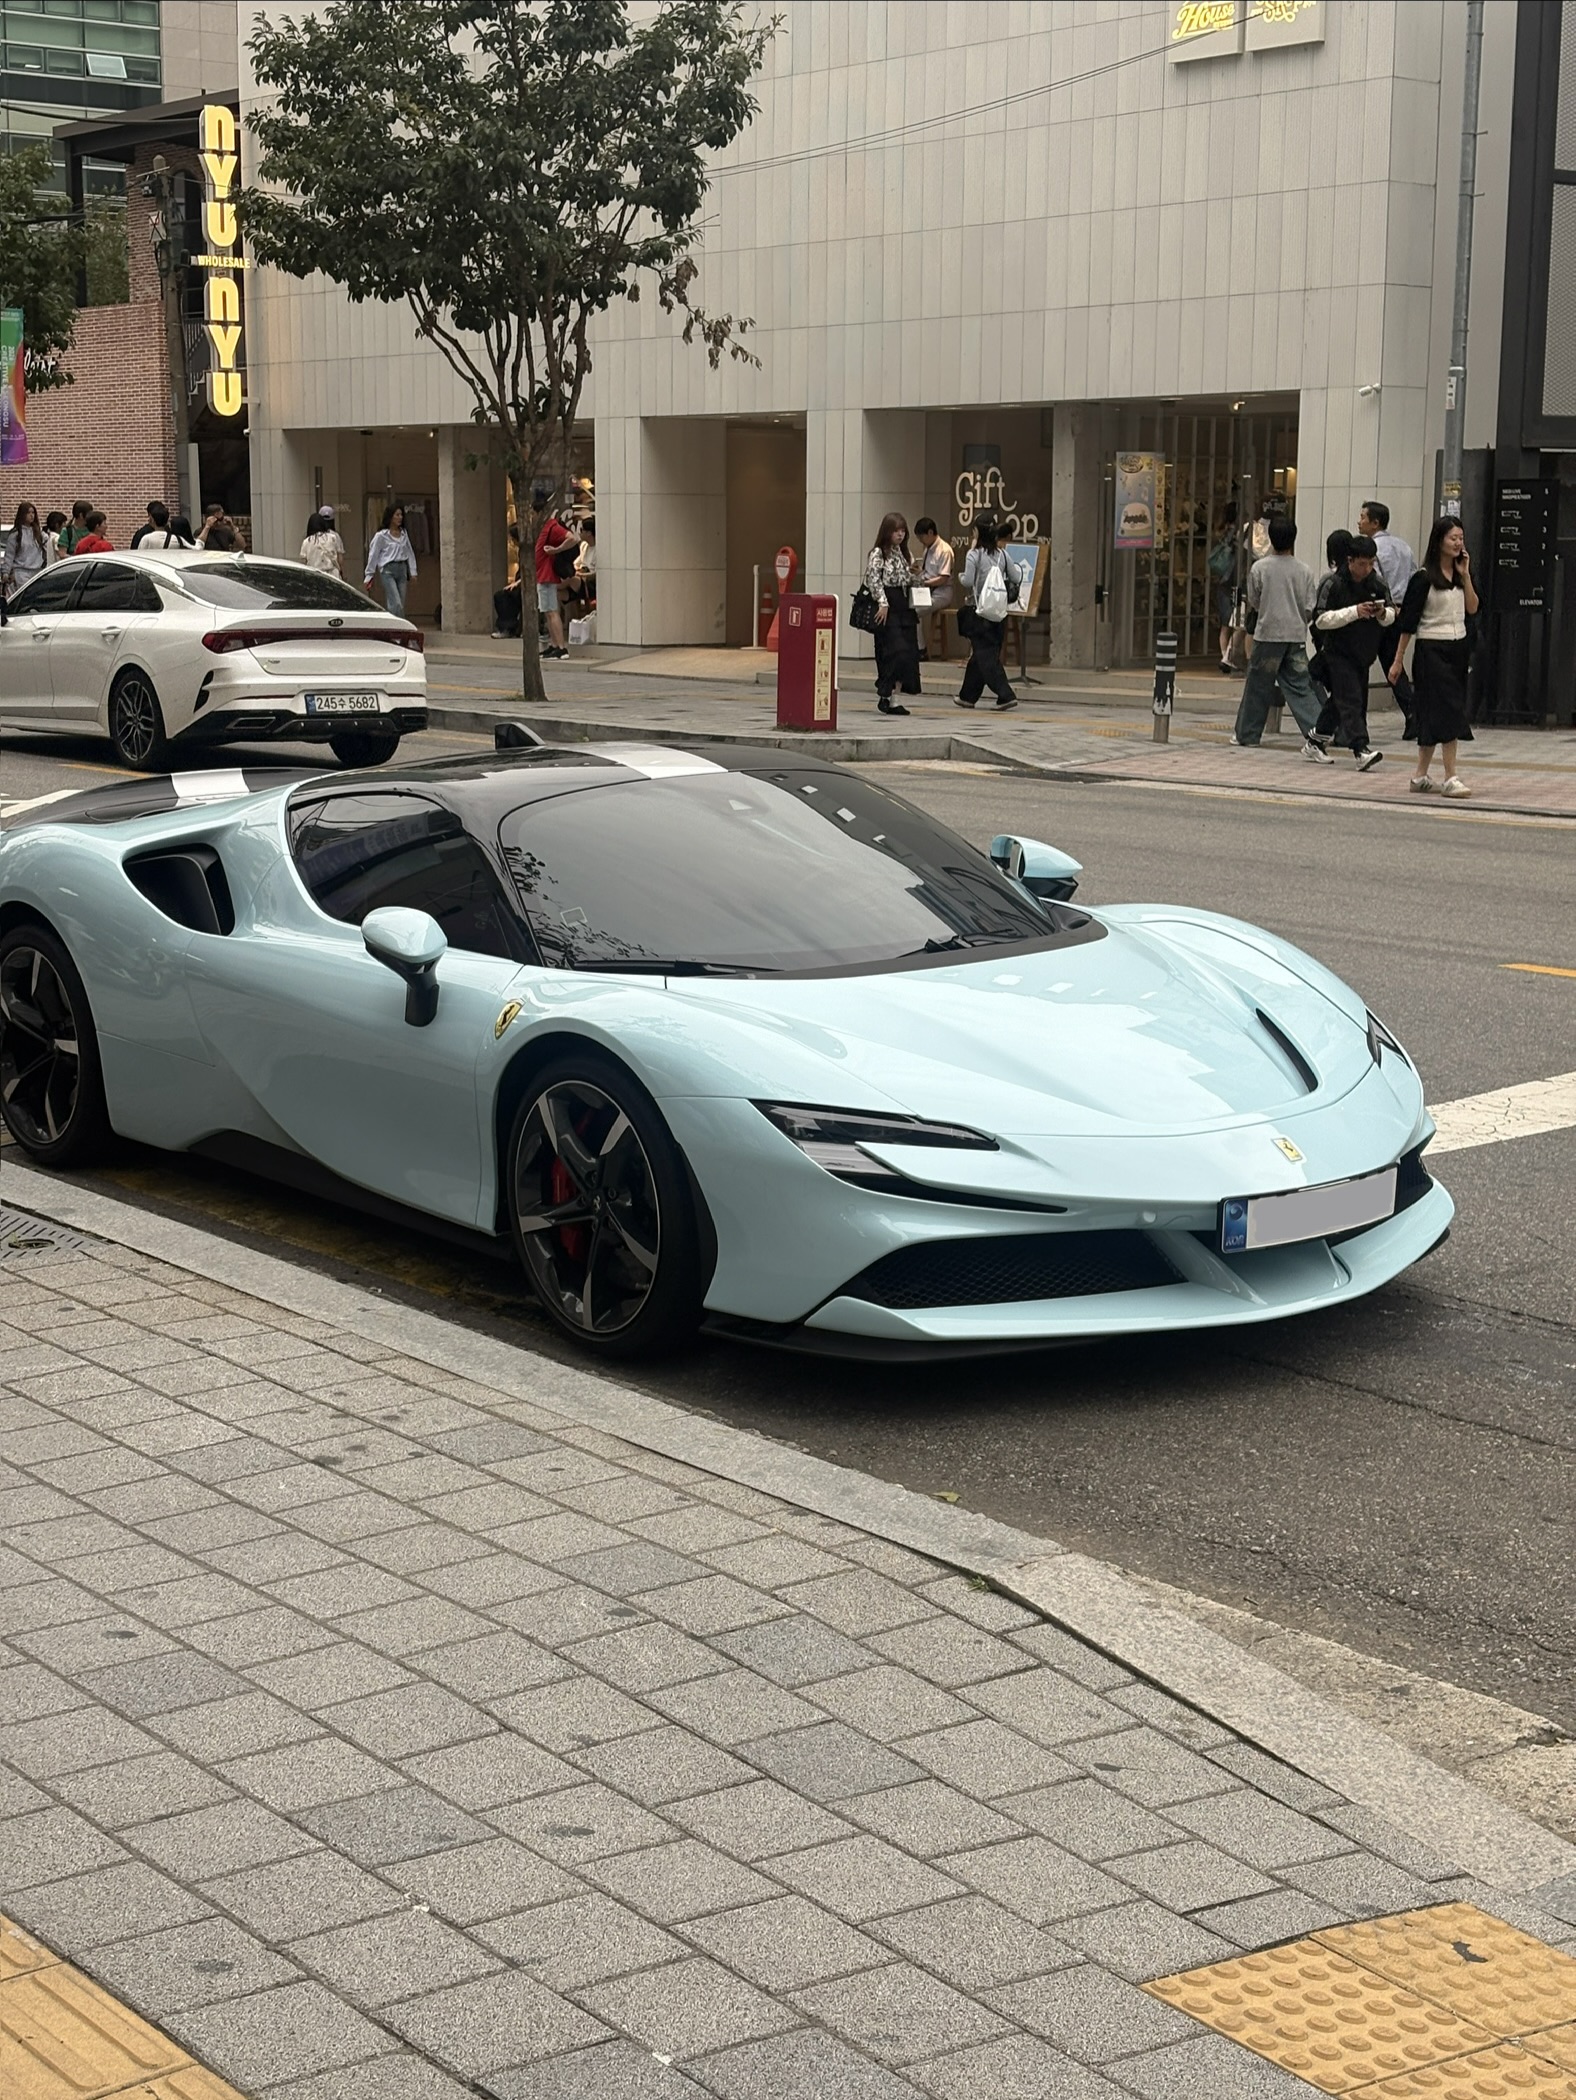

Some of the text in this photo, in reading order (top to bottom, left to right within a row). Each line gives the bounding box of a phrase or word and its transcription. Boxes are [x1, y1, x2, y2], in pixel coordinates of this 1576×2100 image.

[1173, 2, 1235, 38] House
[198, 254, 250, 268] WHOLESALE
[956, 466, 1017, 526] Gift
[317, 697, 347, 710] 245수
[349, 697, 375, 709] 5682
